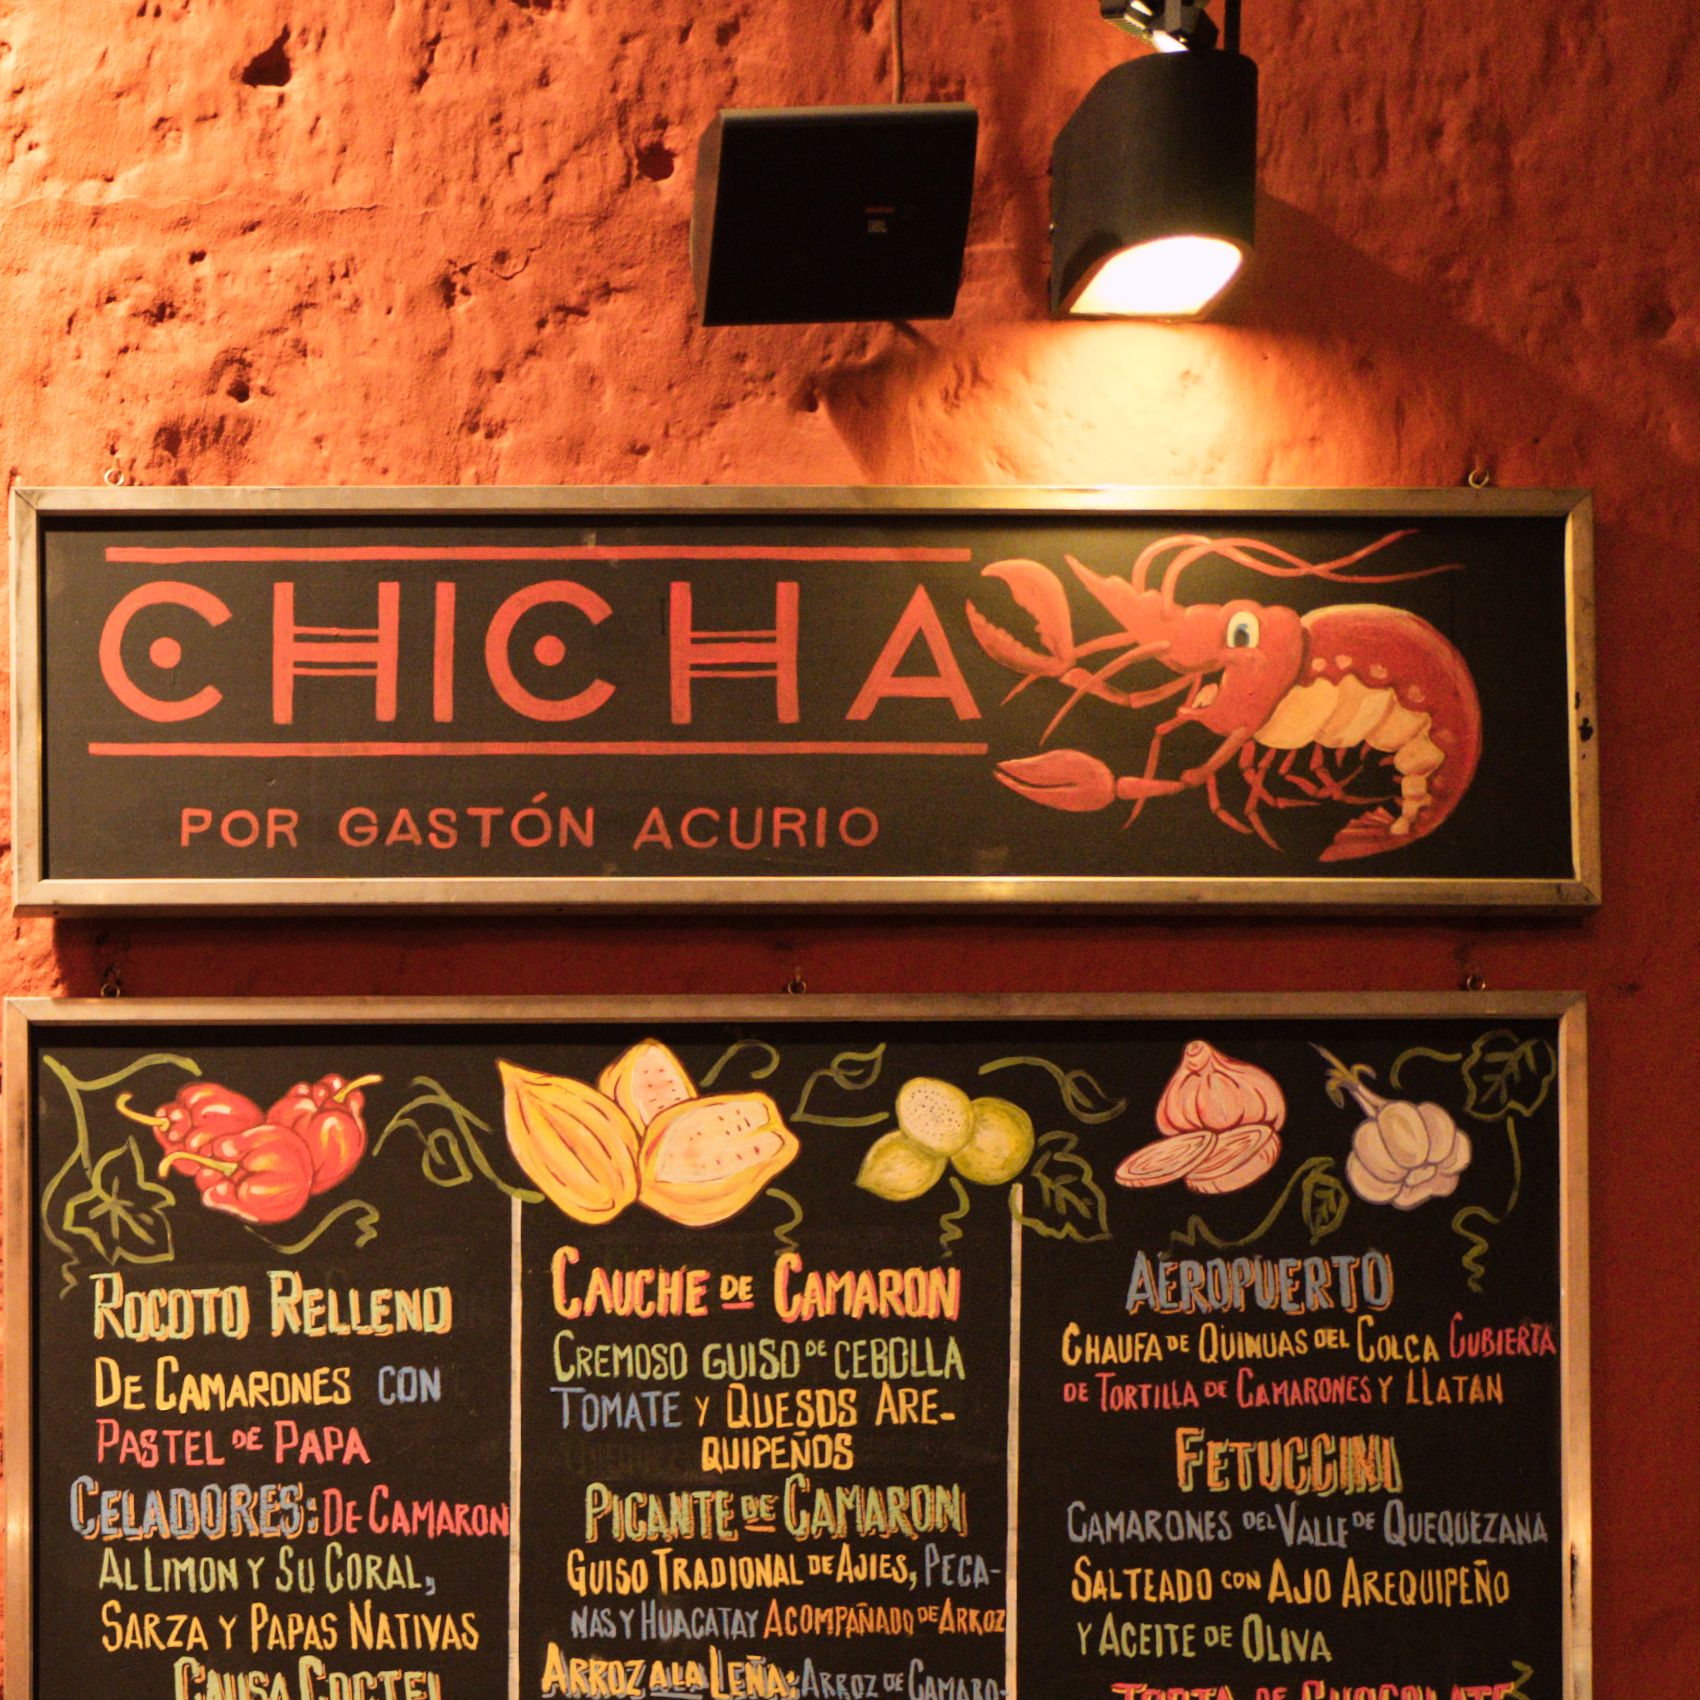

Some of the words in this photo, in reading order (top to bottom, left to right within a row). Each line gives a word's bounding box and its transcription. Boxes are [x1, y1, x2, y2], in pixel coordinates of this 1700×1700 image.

[97, 580, 983, 724] CHICHA
[179, 806, 300, 850] POR
[336, 790, 595, 850] GASTÓN
[632, 804, 881, 850] ACURIO
[89, 1271, 251, 1341] ROCOTO
[266, 1270, 453, 1338] RELLENO
[551, 1245, 711, 1321] CAUCHE
[719, 1273, 754, 1302] DE
[773, 1251, 961, 1323] CAMARON
[1125, 1249, 1394, 1316] AEROPUERTO
[552, 1329, 688, 1384] CREMOSO
[702, 1338, 800, 1380] GUISO
[805, 1340, 828, 1357] DE
[834, 1336, 965, 1381] CEBOLLA
[1061, 1322, 1163, 1366] CHAUFA
[1167, 1334, 1190, 1353] DE
[1198, 1323, 1308, 1362] QUINUAS
[1314, 1327, 1351, 1350] DEL
[1357, 1315, 1439, 1365] COLCA
[1449, 1311, 1557, 1358] CUBIERTA
[95, 1356, 145, 1409] DE
[155, 1355, 352, 1414] CAMARONES
[377, 1366, 442, 1405] CON
[549, 1386, 682, 1432] TOMATE
[695, 1395, 709, 1427] Y
[726, 1381, 857, 1428] QUESOS
[875, 1381, 956, 1427] ARE-
[1063, 1381, 1089, 1403] DE
[1095, 1371, 1199, 1413] TORTILLA
[1204, 1379, 1228, 1398] DE
[1236, 1367, 1372, 1409] CAMARONES
[1377, 1374, 1393, 1403] Y
[1405, 1368, 1503, 1408] LLATAN
[96, 1418, 225, 1467] PASTEL
[232, 1428, 264, 1451] DE
[274, 1420, 371, 1466] PAPA
[701, 1430, 854, 1473] QUIPEÑOS
[1175, 1426, 1404, 1498] FETUCCINI
[69, 1475, 318, 1541] CELADORES:
[322, 1487, 363, 1535] DE
[367, 1484, 510, 1538] CAMARON
[584, 1482, 740, 1542] PICANTE
[741, 1494, 780, 1521] DE
[783, 1473, 968, 1540] CAMARON
[1067, 1500, 1233, 1546] CAMARONES
[1242, 1511, 1277, 1531] DEL
[1275, 1502, 1349, 1549] VALLE
[1352, 1510, 1376, 1529] DE
[1383, 1501, 1548, 1547] QUEQUEZANA
[98, 1547, 139, 1593] AL
[143, 1546, 239, 1593] LIMON
[247, 1557, 265, 1592] Y
[276, 1545, 315, 1594] SU
[322, 1541, 436, 1596] CORAL,
[566, 1548, 648, 1596] GUISO
[652, 1547, 804, 1593] TRADIONAL
[808, 1553, 833, 1576] DE
[835, 1542, 918, 1592] AJIES,
[924, 1543, 1001, 1589] PECA-
[1071, 1555, 1214, 1604] SALTEADO
[1221, 1570, 1261, 1591] CON
[1268, 1557, 1331, 1605] AJO
[1341, 1556, 1510, 1608] AREQUIPEÑO
[101, 1600, 209, 1654] SARZA
[218, 1614, 238, 1649] Y
[250, 1601, 338, 1653] PAPAS
[349, 1599, 479, 1652] NATIVAS
[571, 1604, 617, 1640] NAS
[619, 1608, 635, 1635] Y
[641, 1599, 758, 1640] HUACATAY
[763, 1598, 915, 1640] ACOMPAÑADO
[917, 1605, 939, 1623] DE
[937, 1597, 1006, 1635] ARROZ
[1077, 1622, 1095, 1656] Y
[1098, 1611, 1196, 1658] ACEITE
[1204, 1625, 1233, 1647] DE
[1241, 1613, 1333, 1664] OLIVA
[541, 1642, 649, 1700] ARROZ
[802, 1658, 878, 1699] ARROZ
[883, 1671, 903, 1692] DE
